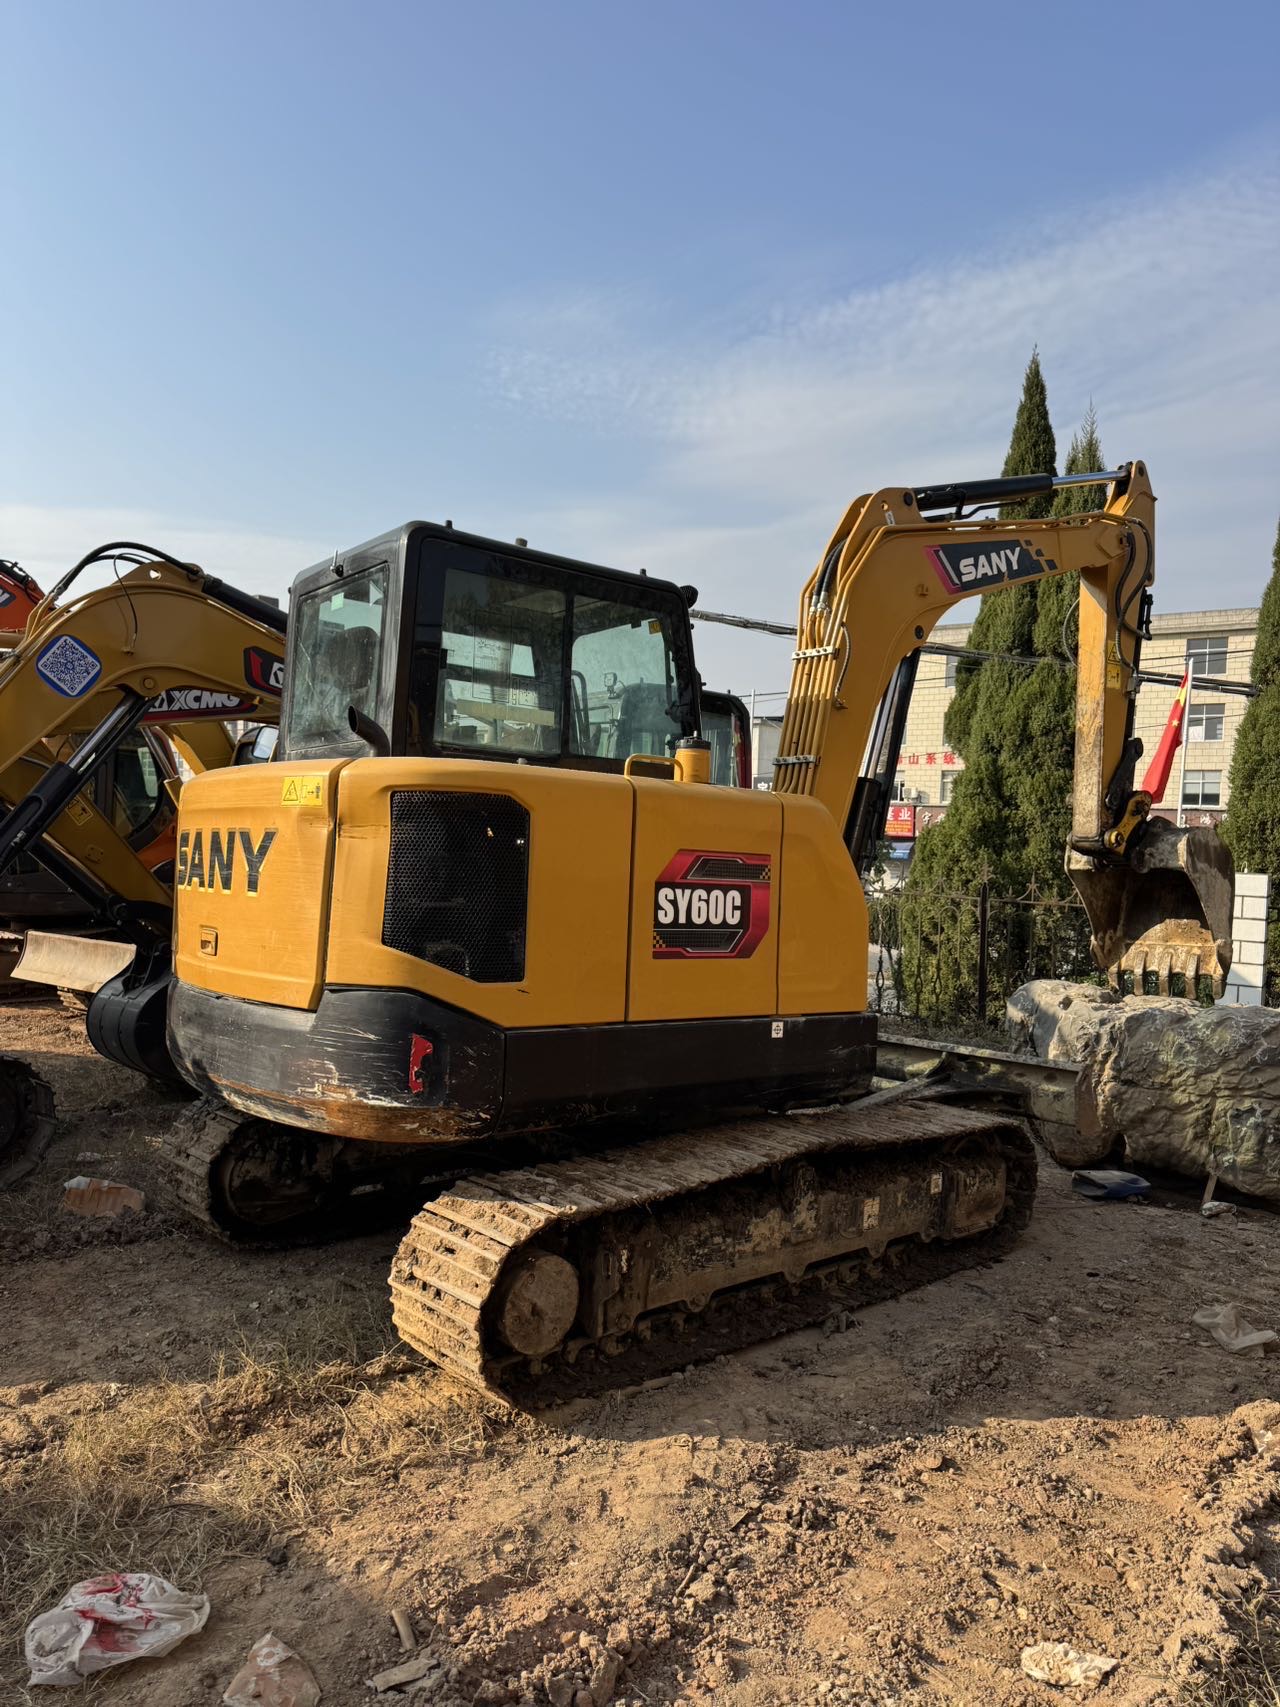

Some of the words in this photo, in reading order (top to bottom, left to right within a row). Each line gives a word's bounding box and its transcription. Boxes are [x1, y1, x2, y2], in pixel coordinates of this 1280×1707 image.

[959, 547, 1021, 582] SANY
[169, 689, 241, 711] XCMG
[178, 828, 279, 897] SANY
[657, 887, 742, 925] SY60C
